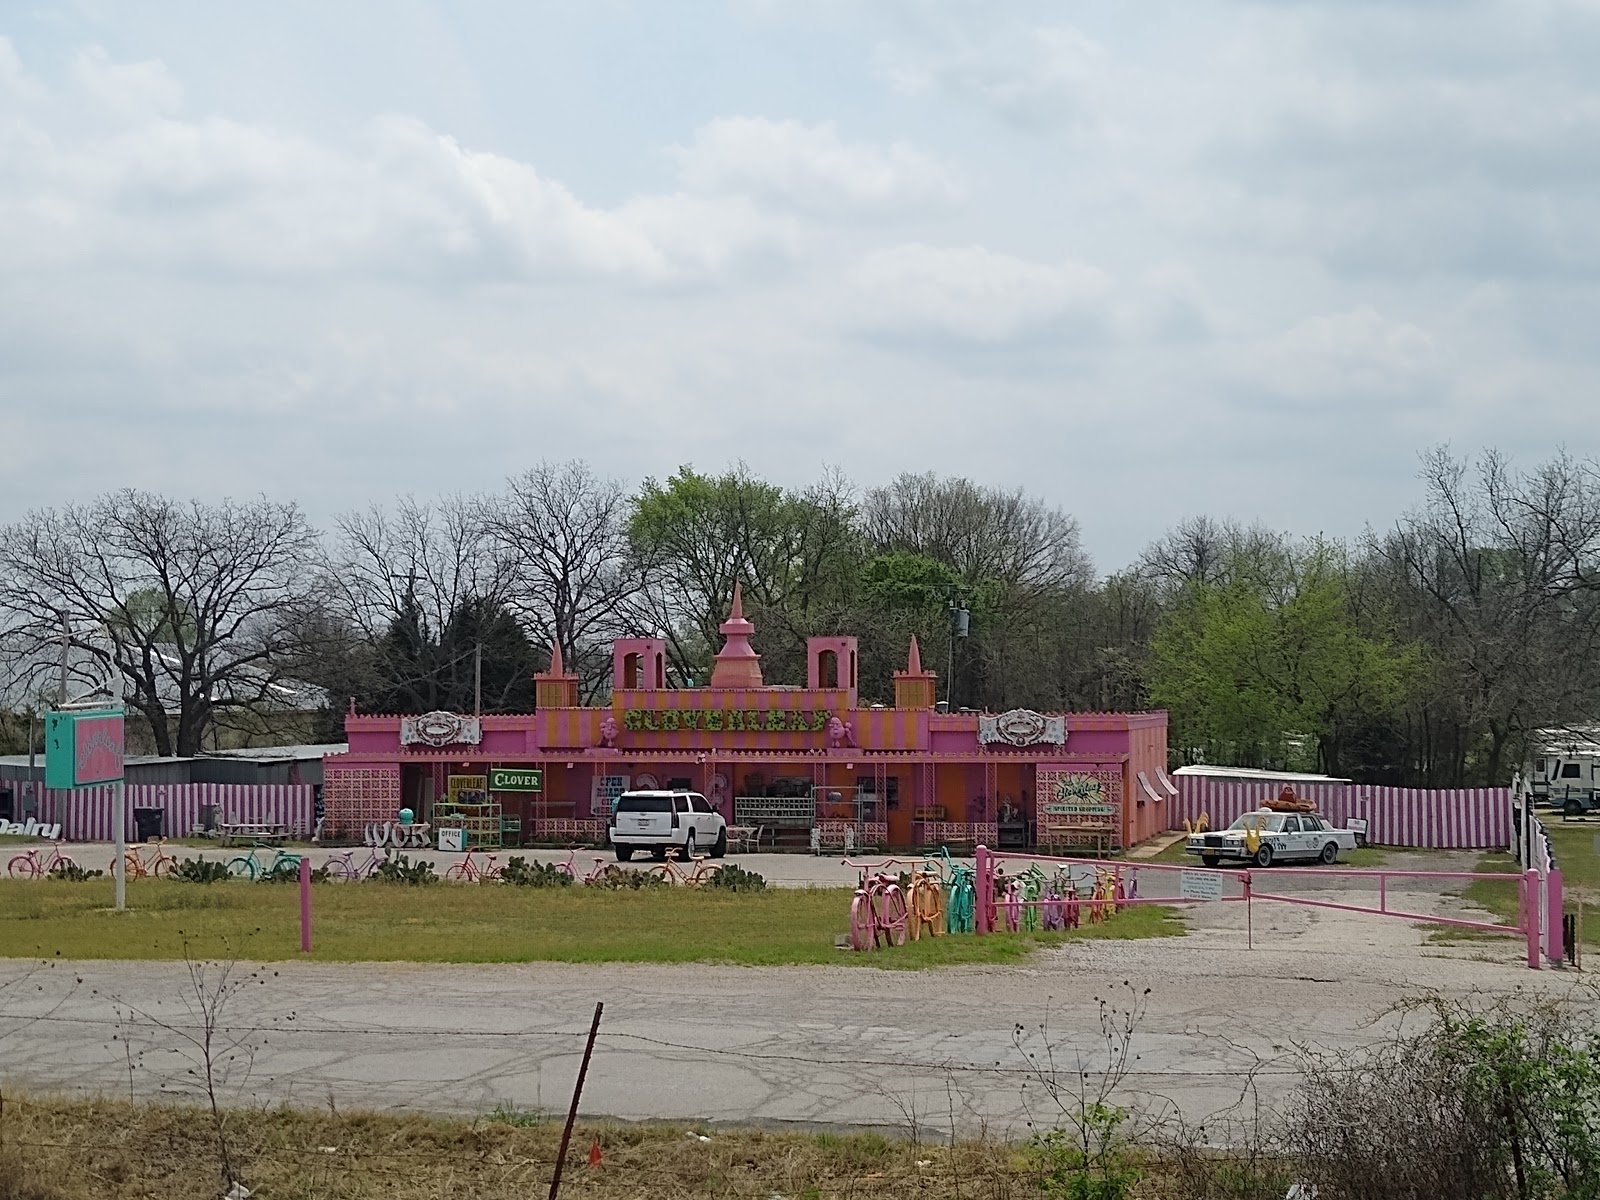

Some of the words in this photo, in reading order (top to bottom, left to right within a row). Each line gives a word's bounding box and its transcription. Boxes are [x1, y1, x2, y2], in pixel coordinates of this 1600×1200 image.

[623, 708, 833, 731] CLOVERLEAF
[450, 777, 483, 789] CLOVERLEAF
[494, 773, 539, 786] CLOVER
[441, 830, 461, 838] OFFICE
